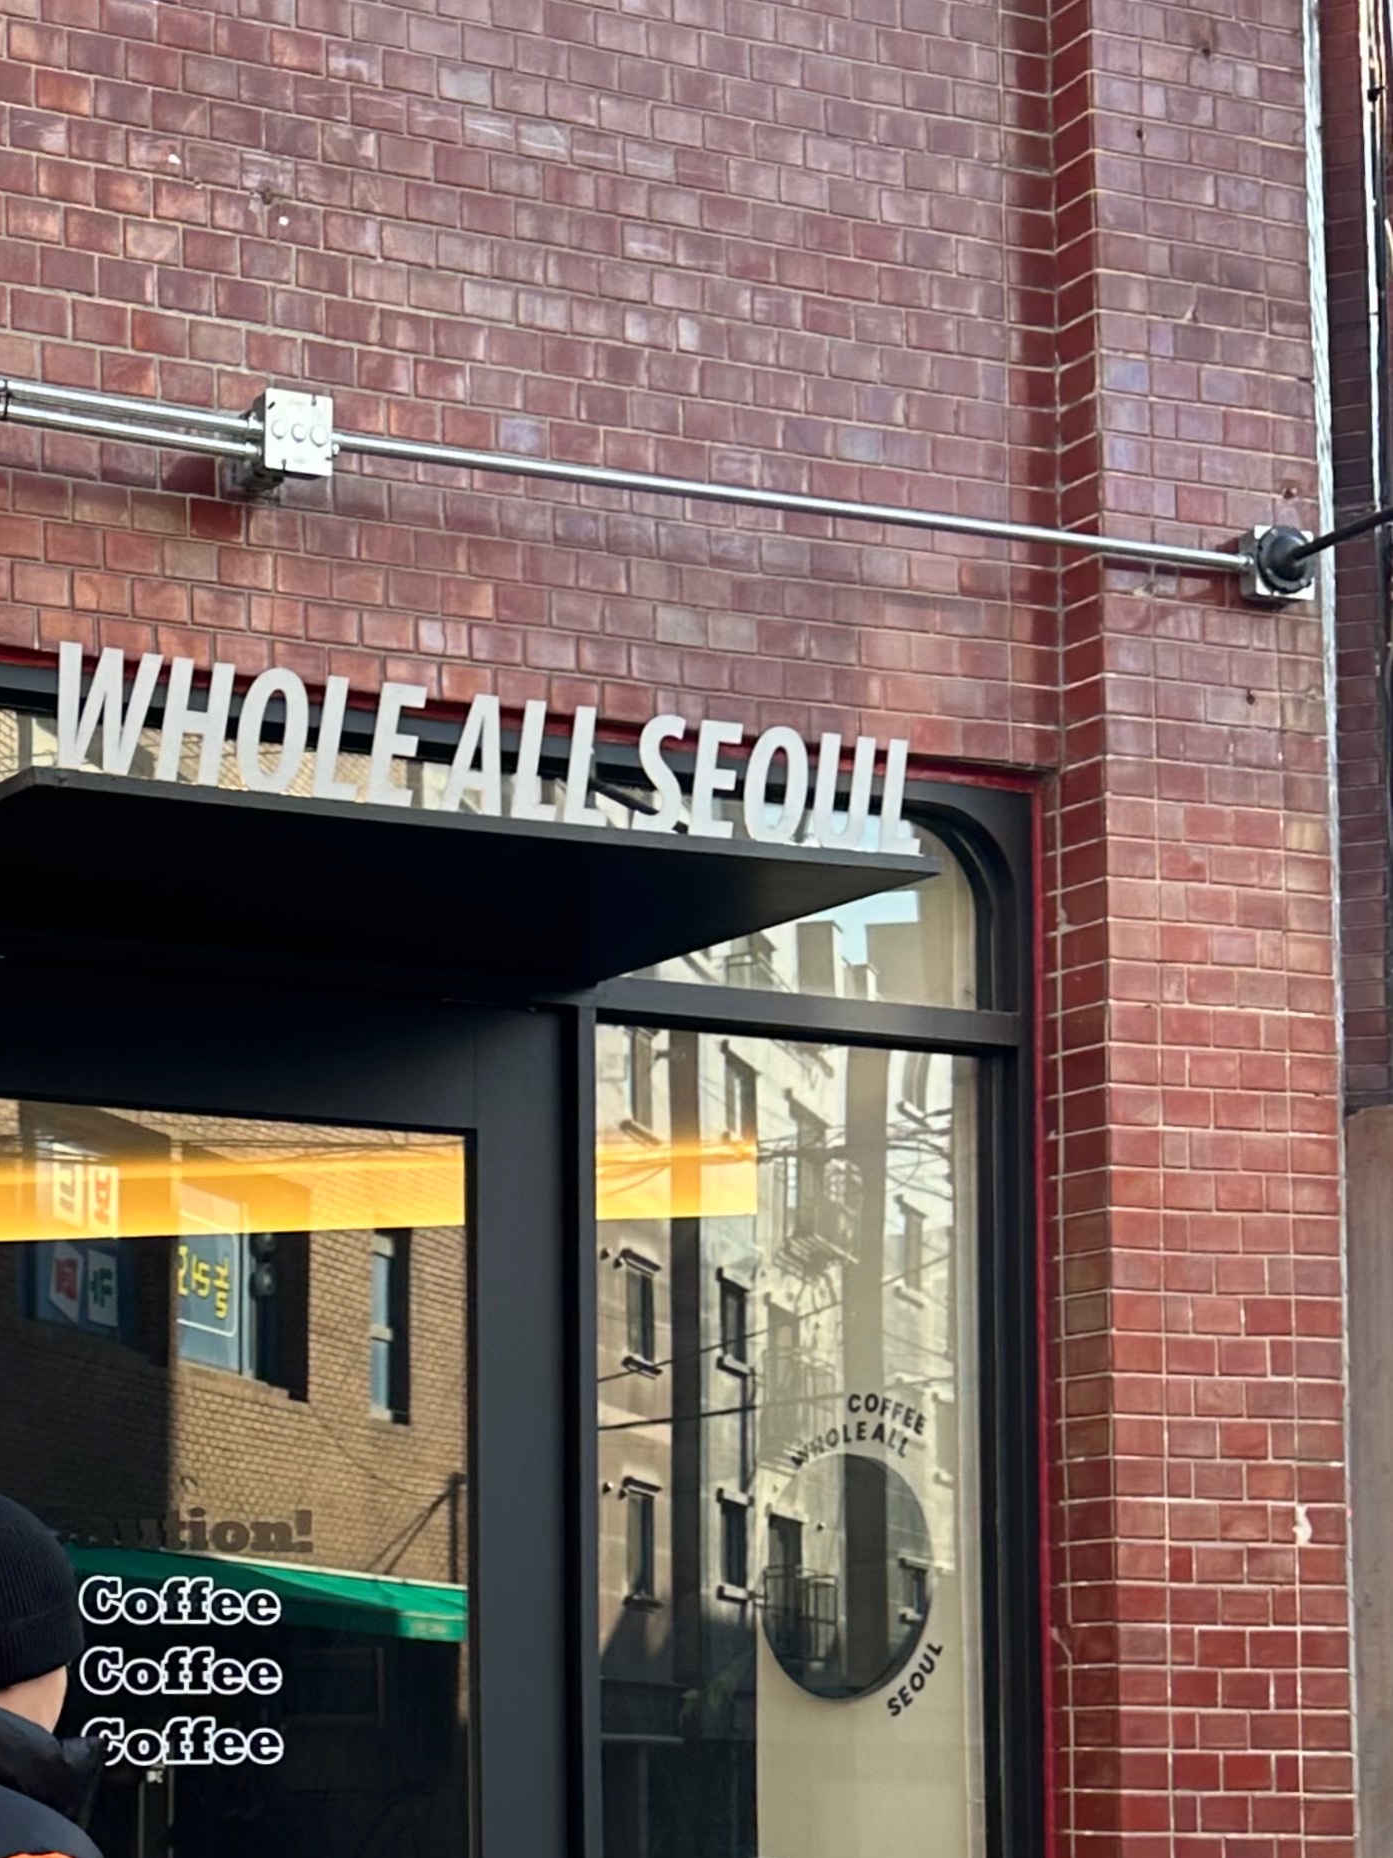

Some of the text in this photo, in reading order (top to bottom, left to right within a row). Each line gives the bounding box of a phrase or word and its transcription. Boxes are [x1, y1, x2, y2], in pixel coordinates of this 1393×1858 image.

[57, 641, 923, 856] WHOLE ALL SEOUL
[848, 1393, 927, 1436] COFFEE
[79, 1576, 281, 1625] Coffee
[79, 1646, 283, 1695] Coffee
[887, 1641, 944, 1717] SEOUL
[80, 1716, 284, 1767] Coffee
